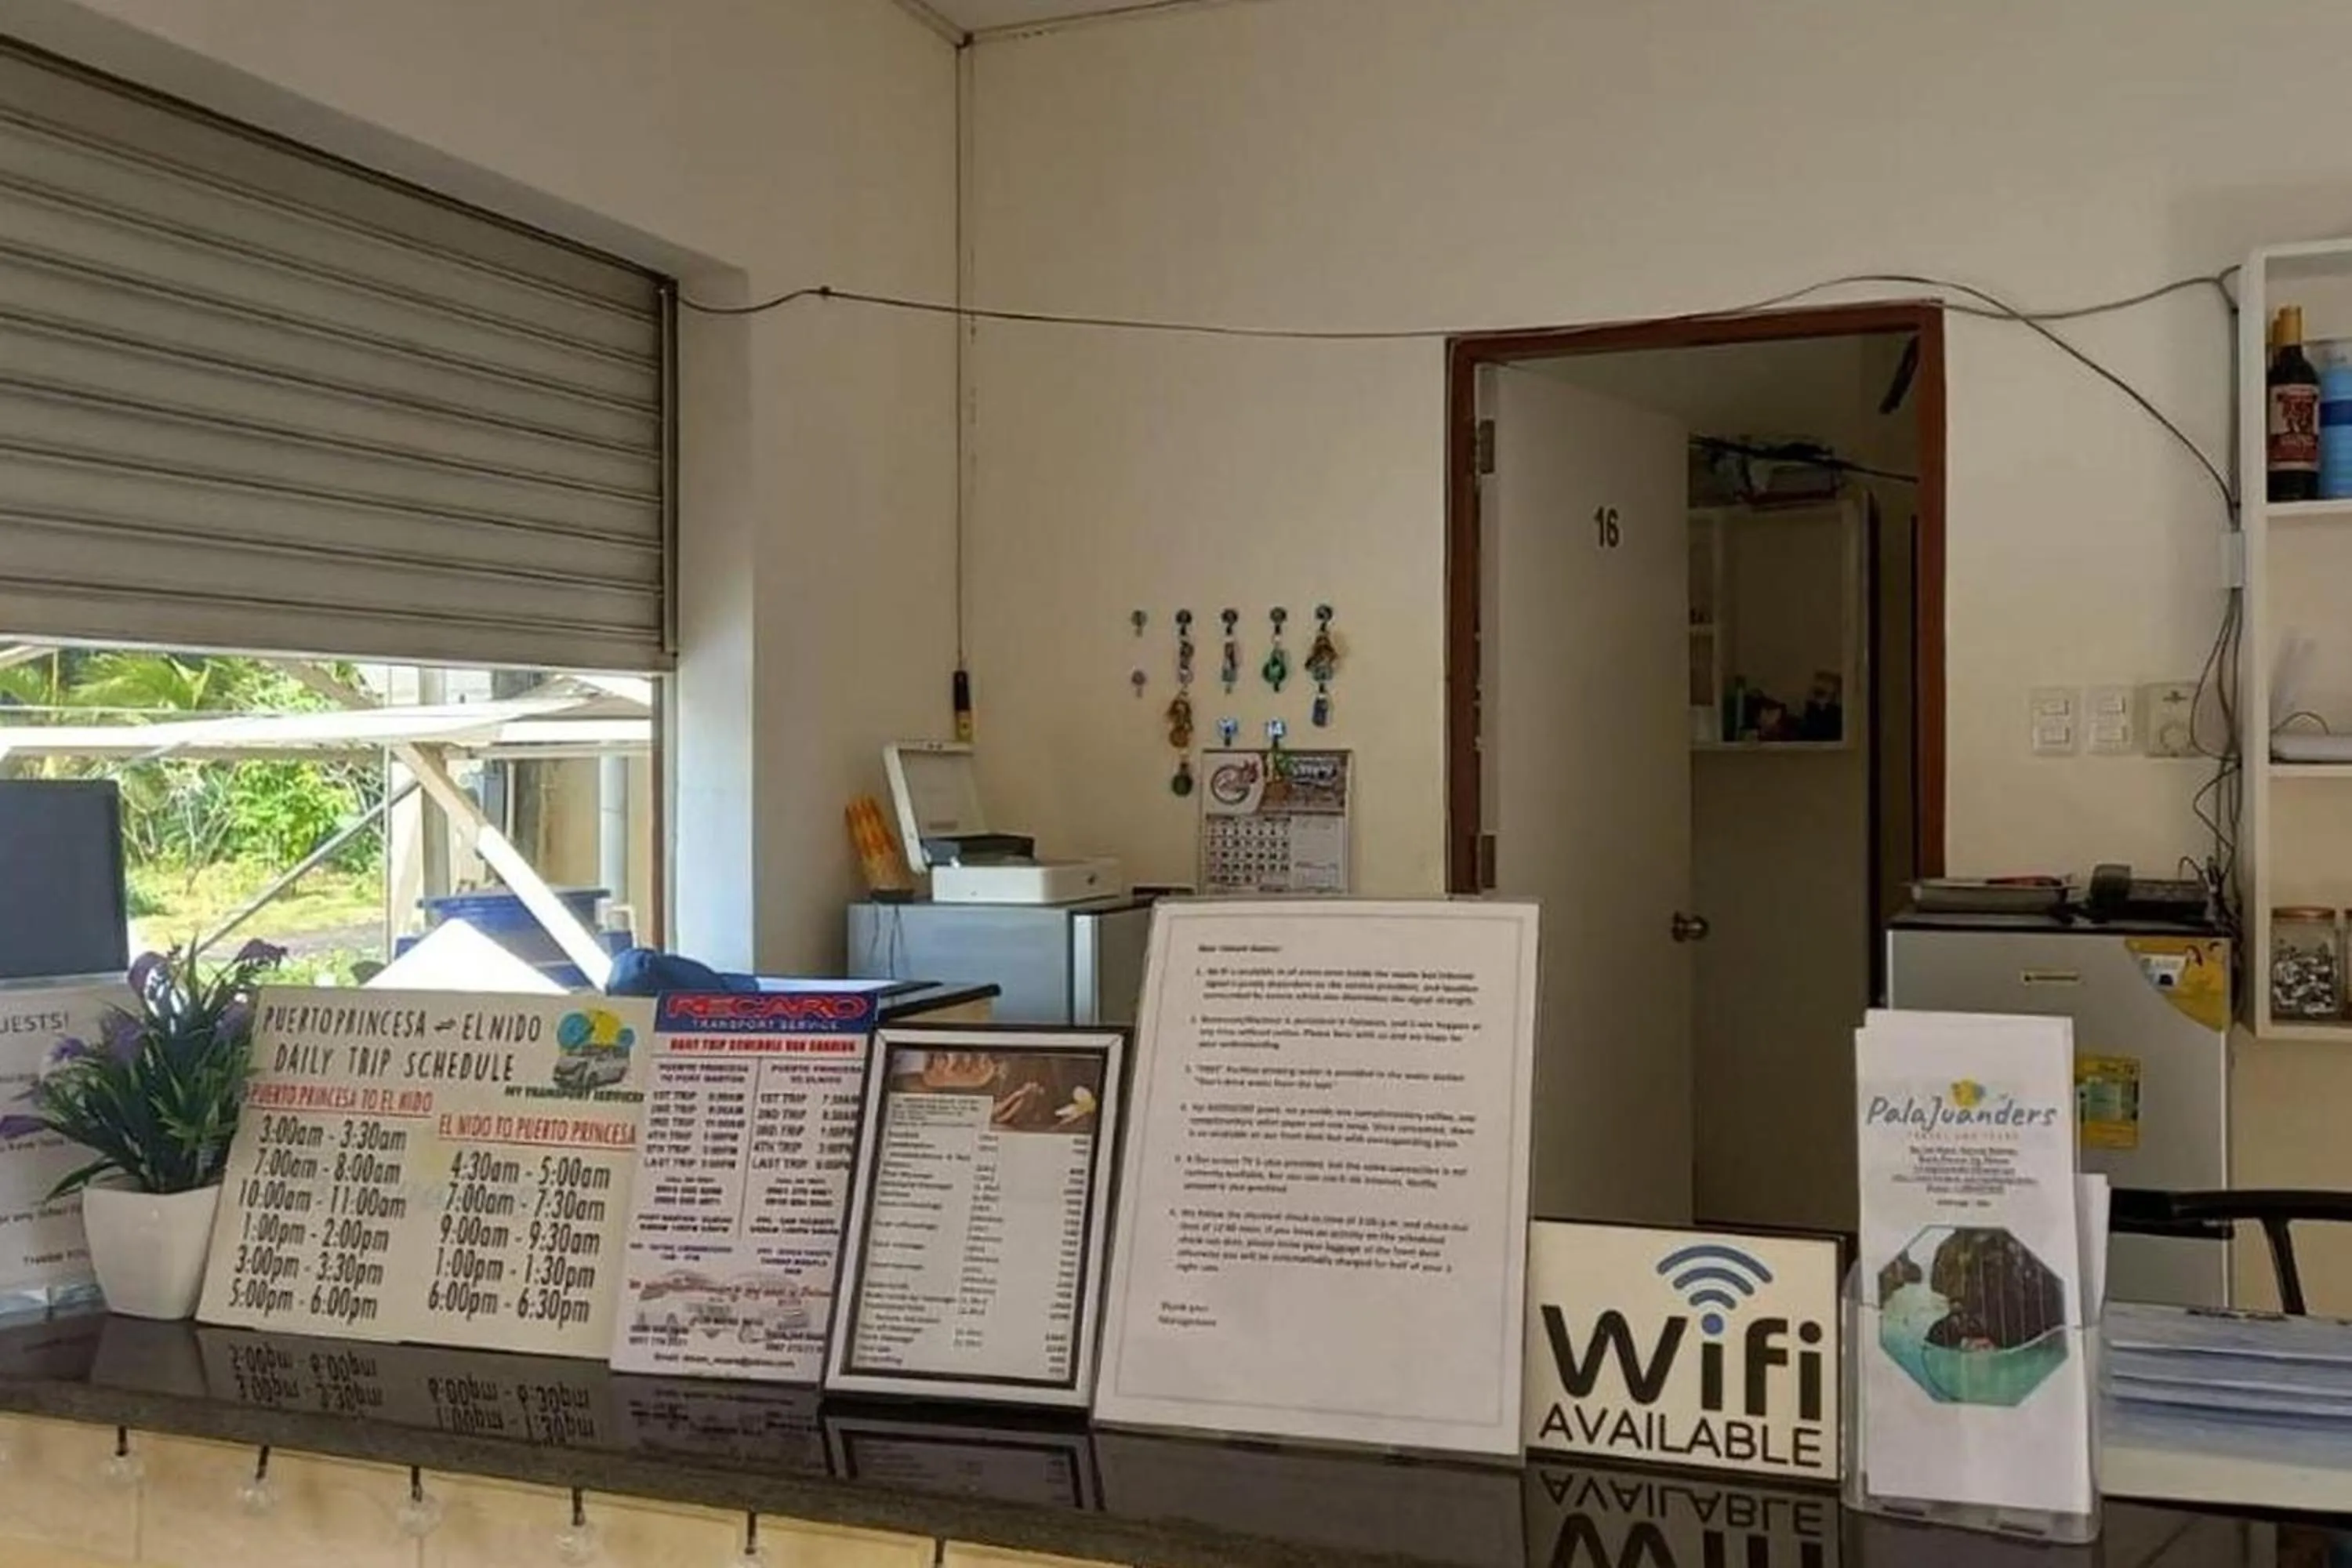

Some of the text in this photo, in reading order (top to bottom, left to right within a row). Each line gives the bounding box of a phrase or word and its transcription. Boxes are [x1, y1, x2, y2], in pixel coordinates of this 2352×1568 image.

[1593, 506, 1619, 547] 16
[273, 1044, 514, 1083] DAILY TRIP SCHEDULE
[251, 1084, 434, 1112] PUERTO PRINCESA TO EL NIDO
[259, 1114, 324, 1147] 3:00am
[339, 1120, 407, 1151] 3:30am
[438, 1114, 452, 1134] EL
[459, 1115, 492, 1136] NIDO
[515, 1117, 567, 1141] PUERTO
[568, 1120, 636, 1144] PRINCESA
[254, 1148, 318, 1179] 7:00am
[334, 1152, 401, 1185] 8:00am
[451, 1151, 521, 1183] 4:30am
[538, 1156, 612, 1189] 5:00am
[238, 1178, 313, 1212] 10:00am
[329, 1185, 408, 1219] 11:00am
[445, 1181, 515, 1215] 7:00am
[534, 1189, 606, 1221] 7:30am
[243, 1212, 307, 1252] 1:00pm
[321, 1218, 390, 1257] 2:00pm
[440, 1214, 510, 1248] 9:00am
[528, 1221, 601, 1255] 9:30am
[235, 1244, 300, 1284] 3:00pm
[316, 1251, 384, 1291] 3:30pm
[436, 1247, 504, 1288] 1:00pm
[524, 1253, 596, 1296] 1:30pm
[229, 1277, 294, 1319] 5:00pm
[310, 1284, 378, 1326] 6:00pm
[427, 1279, 499, 1323] 6:00pm
[517, 1287, 591, 1330] 6:30pm
[1541, 1305, 1824, 1421] Wifi
[1539, 1403, 1822, 1468] AVAILABLE
